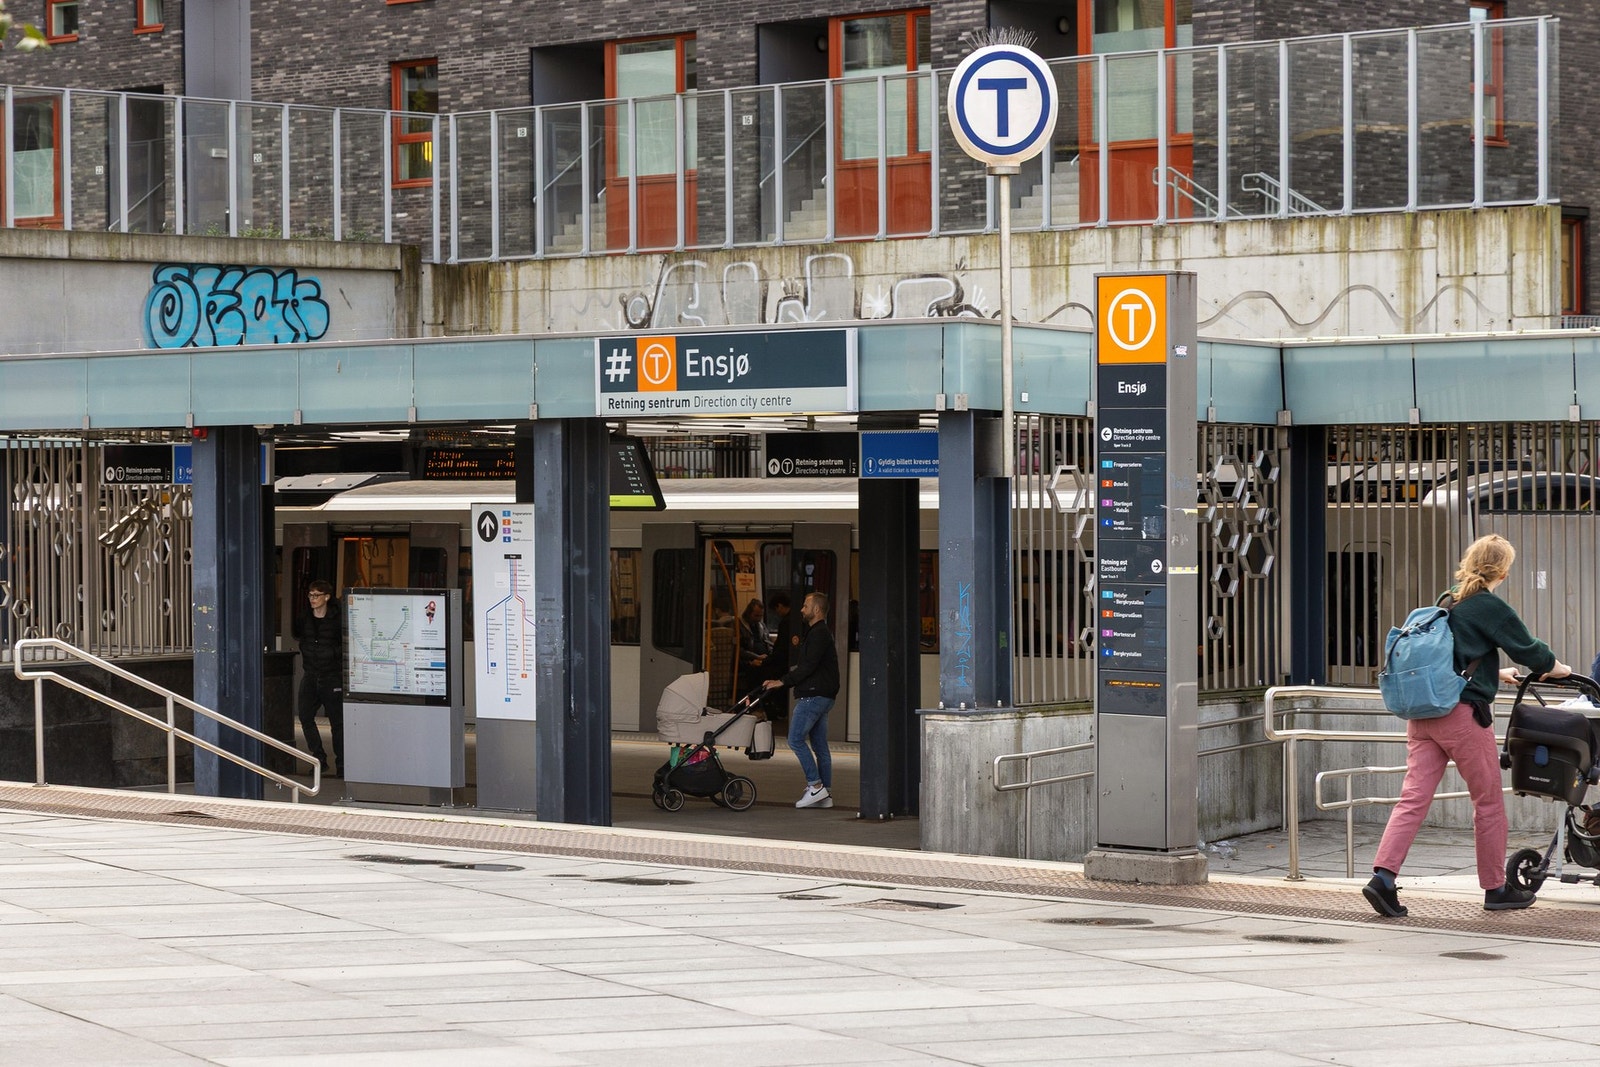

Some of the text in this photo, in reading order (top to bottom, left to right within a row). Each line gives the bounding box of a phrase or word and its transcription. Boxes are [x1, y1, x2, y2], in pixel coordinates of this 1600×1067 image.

[977, 78, 1028, 138] T
[1121, 303, 1143, 342] T
[685, 347, 750, 384] Ensjø
[1117, 381, 1147, 396] Ensjø
[608, 394, 792, 412] Retning sentrum Direction city centre
[1113, 427, 1132, 435] Retning
[1136, 434, 1145, 442] city
[795, 458, 818, 467] Retning
[819, 458, 844, 466] sentrum
[878, 458, 896, 467] Gyldig
[896, 458, 913, 466] billett
[913, 458, 933, 466] kreves
[795, 467, 819, 475] Direction
[820, 467, 830, 475] city
[909, 467, 929, 475] required
[1101, 558, 1120, 566] Retning
